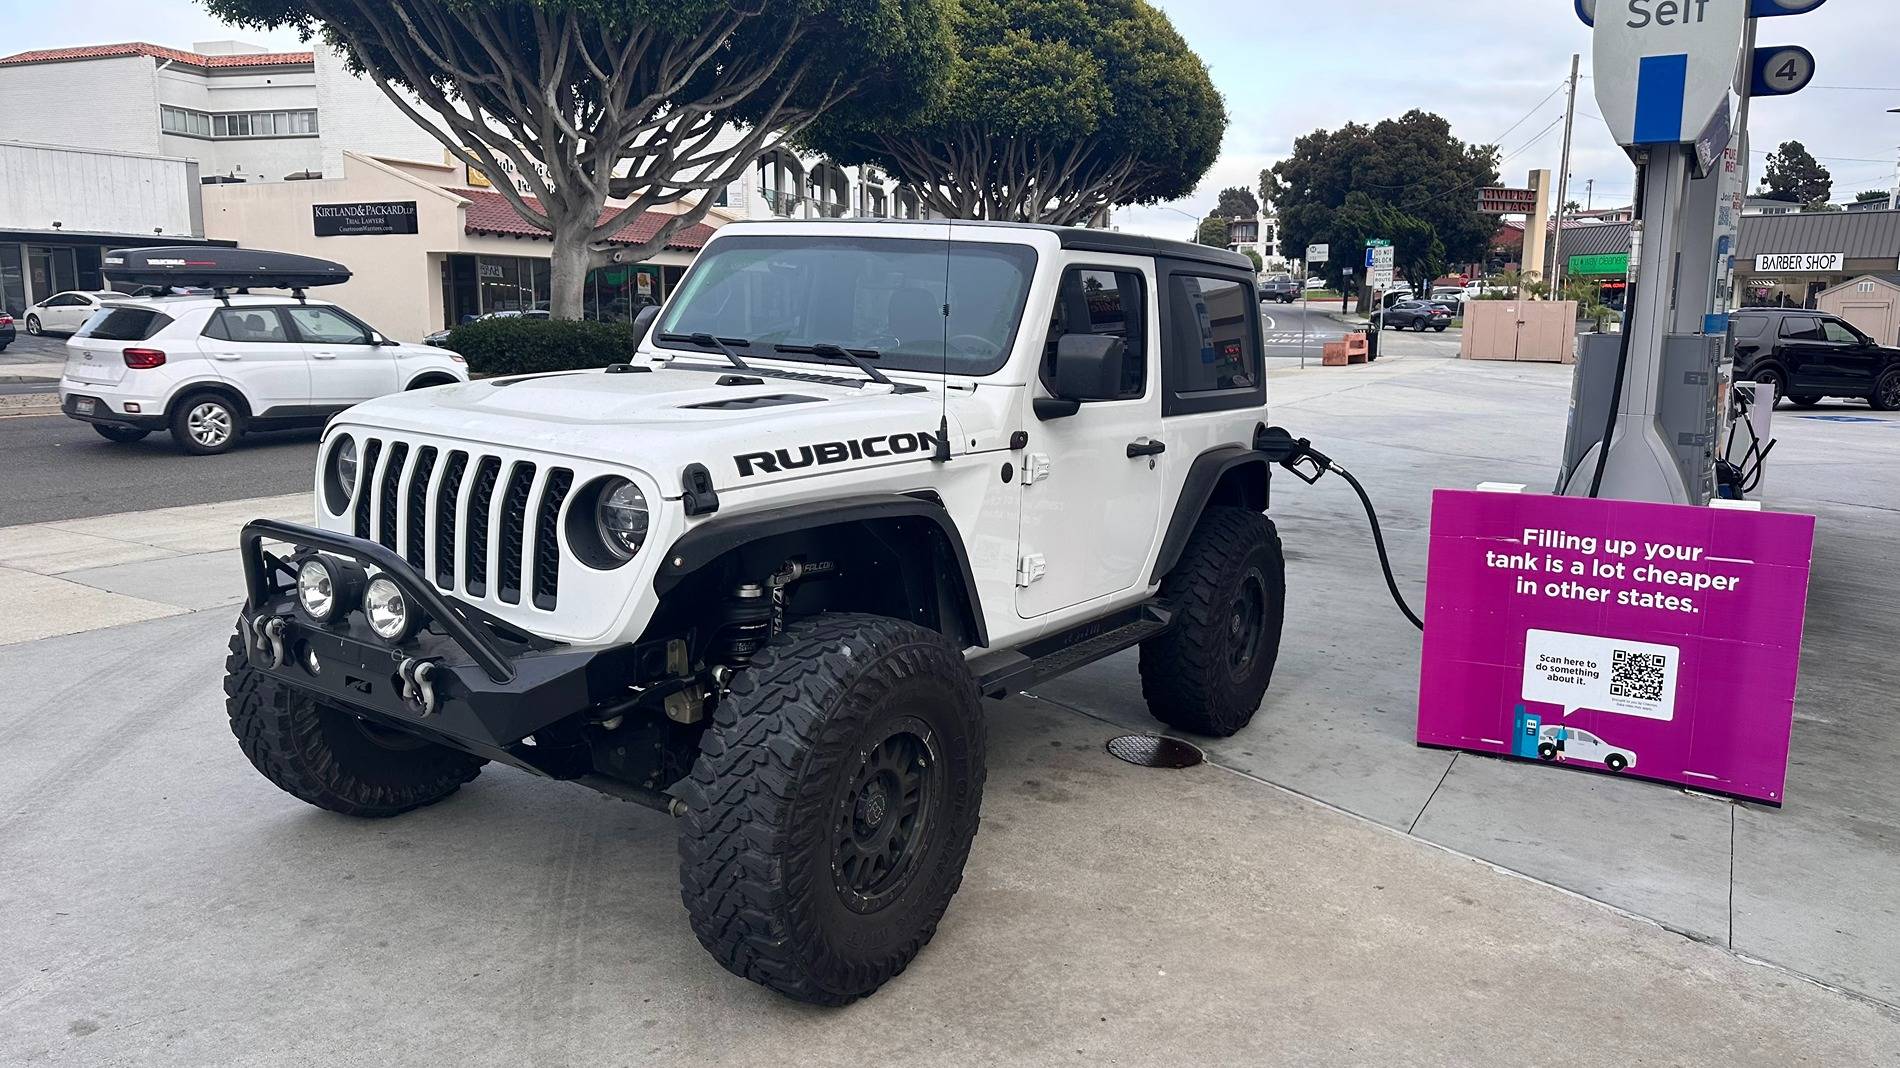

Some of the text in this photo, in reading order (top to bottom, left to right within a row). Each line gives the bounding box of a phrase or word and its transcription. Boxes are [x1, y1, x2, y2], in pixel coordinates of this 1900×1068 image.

[1775, 58, 1797, 81] 4
[1484, 189, 1534, 201] RIVIERA
[1482, 200, 1534, 212] VILLAGE
[1762, 254, 1837, 270] BARBER SHOP
[733, 431, 942, 477] RUBICON
[1523, 528, 1703, 561] Filling up your
[1486, 550, 1740, 591] tank is a lot cheaper
[1516, 575, 1699, 613] in other states.
[1540, 654, 1597, 669] Scan here to
[1535, 663, 1600, 679] do something
[1547, 674, 1586, 686] about it.
